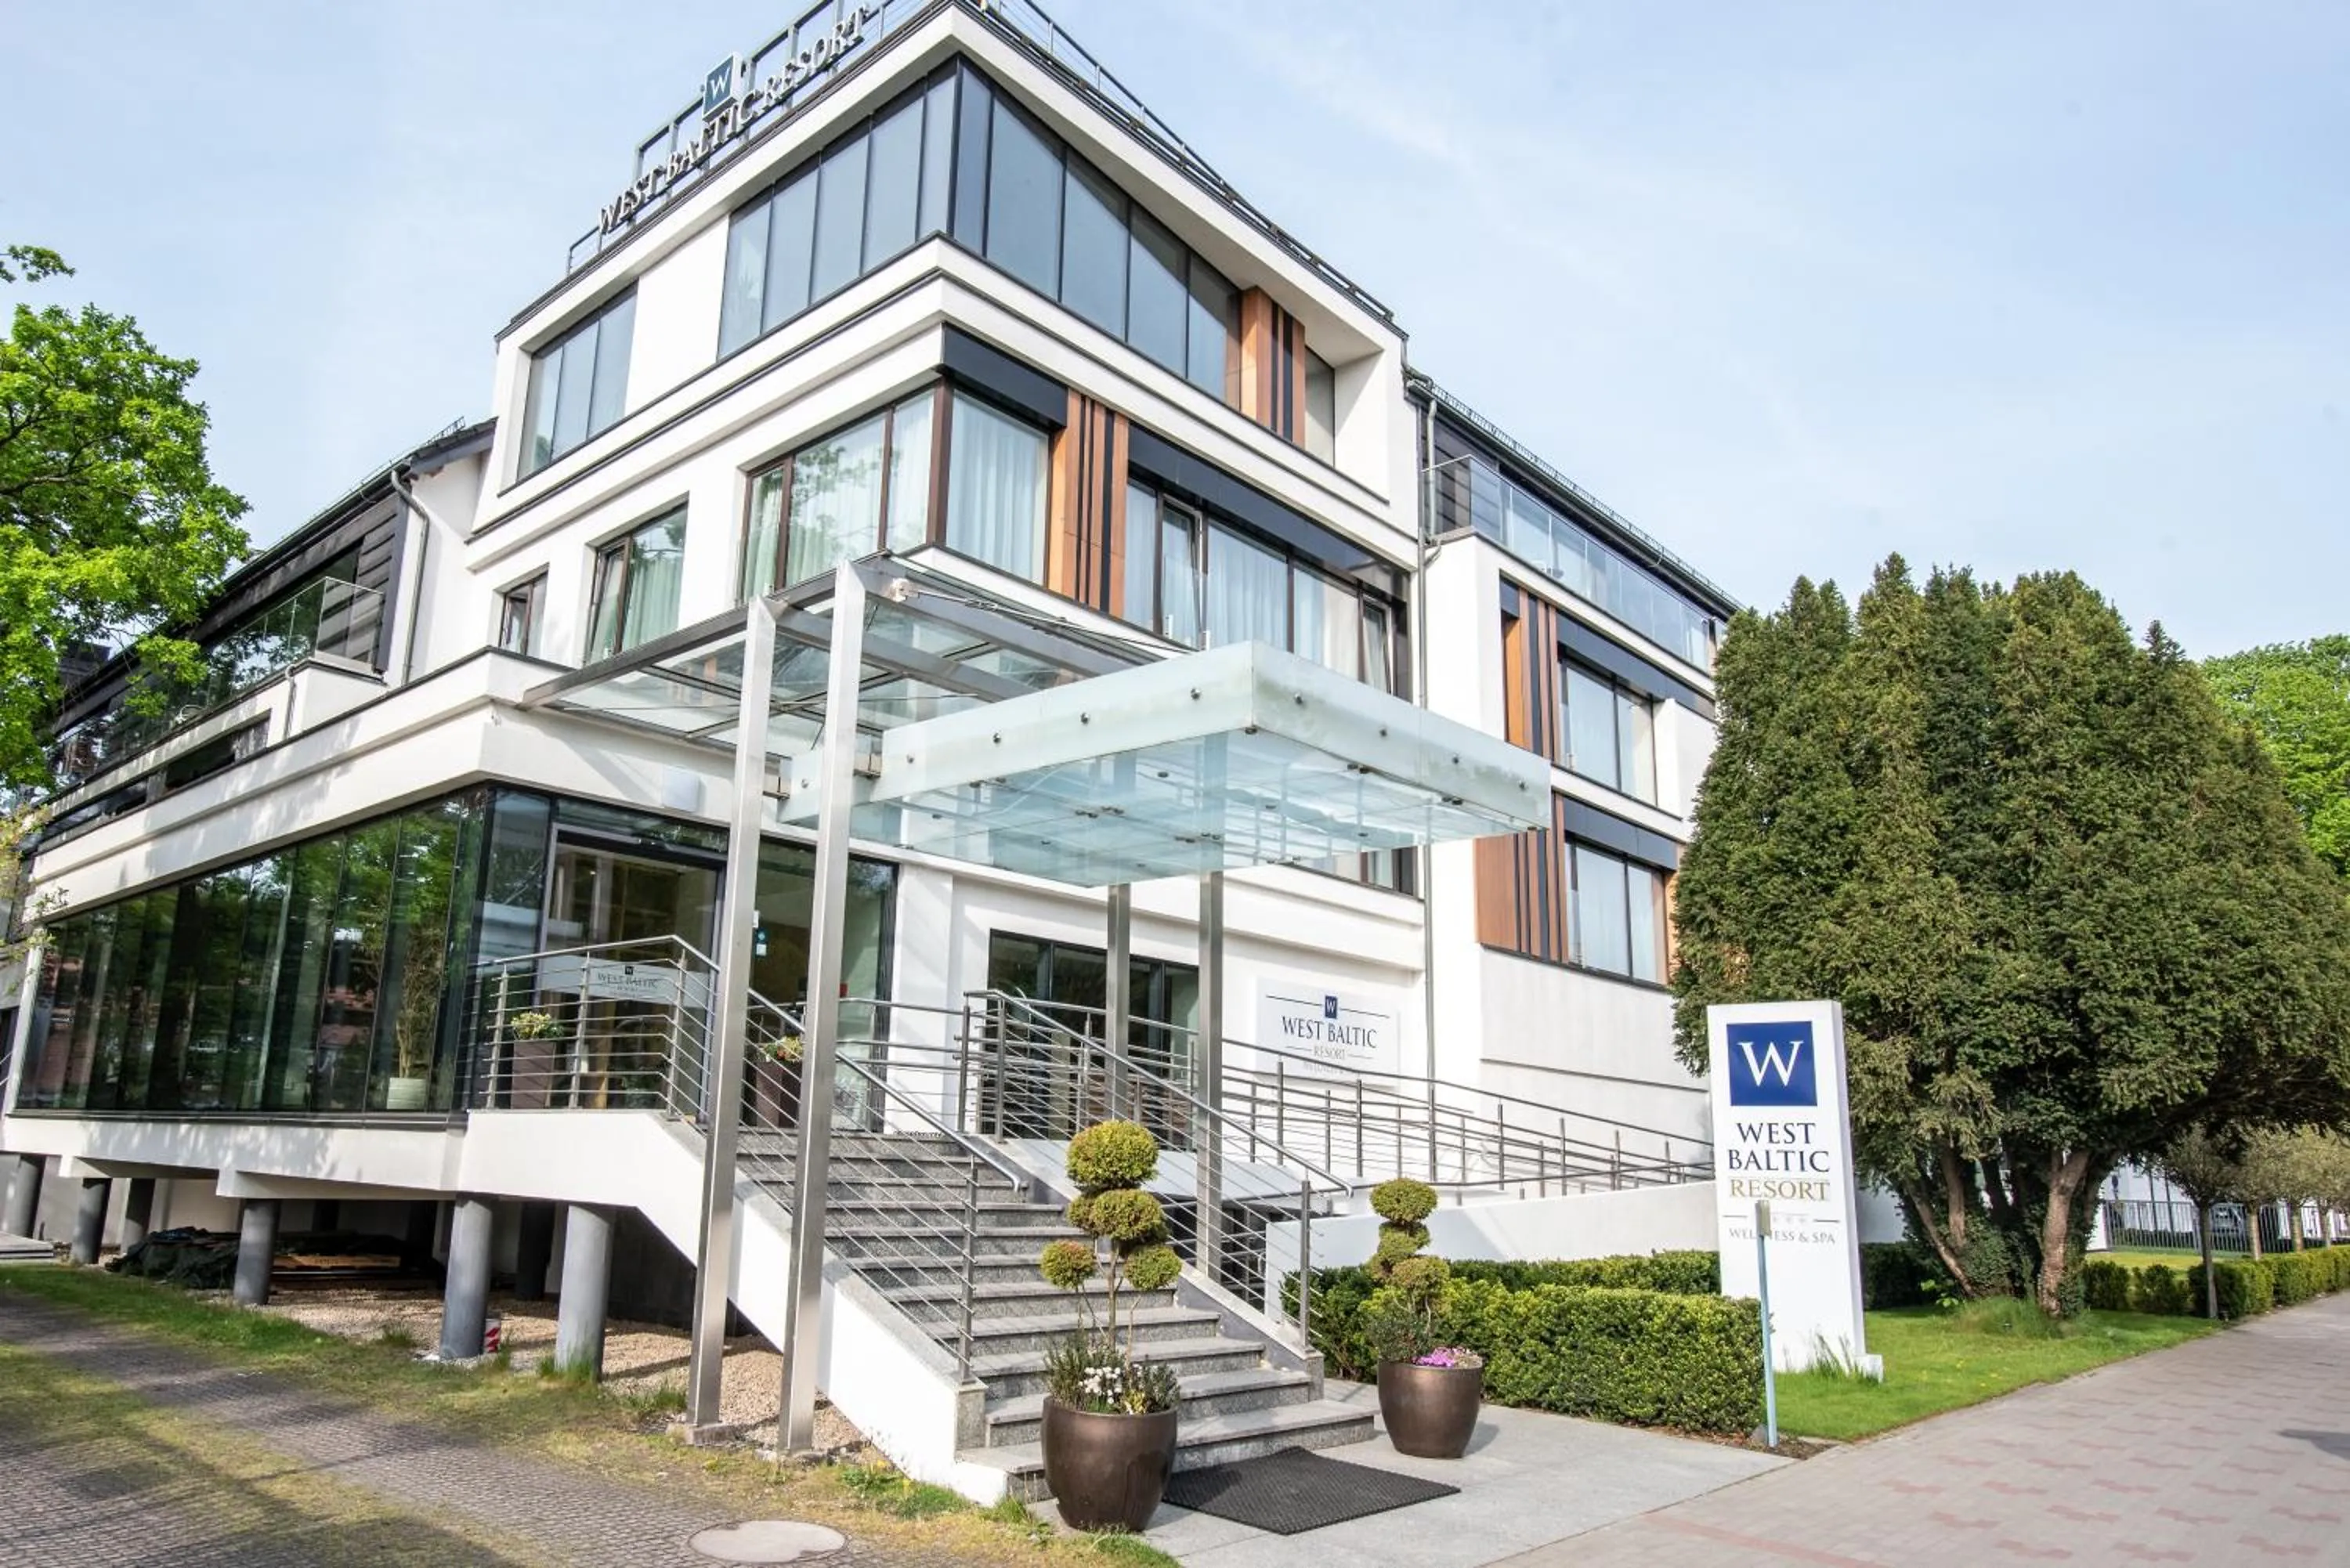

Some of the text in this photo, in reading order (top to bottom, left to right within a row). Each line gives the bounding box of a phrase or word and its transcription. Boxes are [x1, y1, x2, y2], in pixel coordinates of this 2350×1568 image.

[710, 67, 730, 99] W
[598, 4, 869, 235] WEST BALTIC RESORT
[1326, 999, 1336, 1011] W
[1282, 1016, 1378, 1049] WEST BALTIC
[1314, 1046, 1346, 1060] RESORT
[1737, 1040, 1804, 1087] W
[1736, 1122, 1816, 1144] WEST
[1728, 1149, 1830, 1173] BALTIC
[1730, 1179, 1831, 1201] RESORT
[1729, 1227, 1835, 1245] WELESS & SPA
